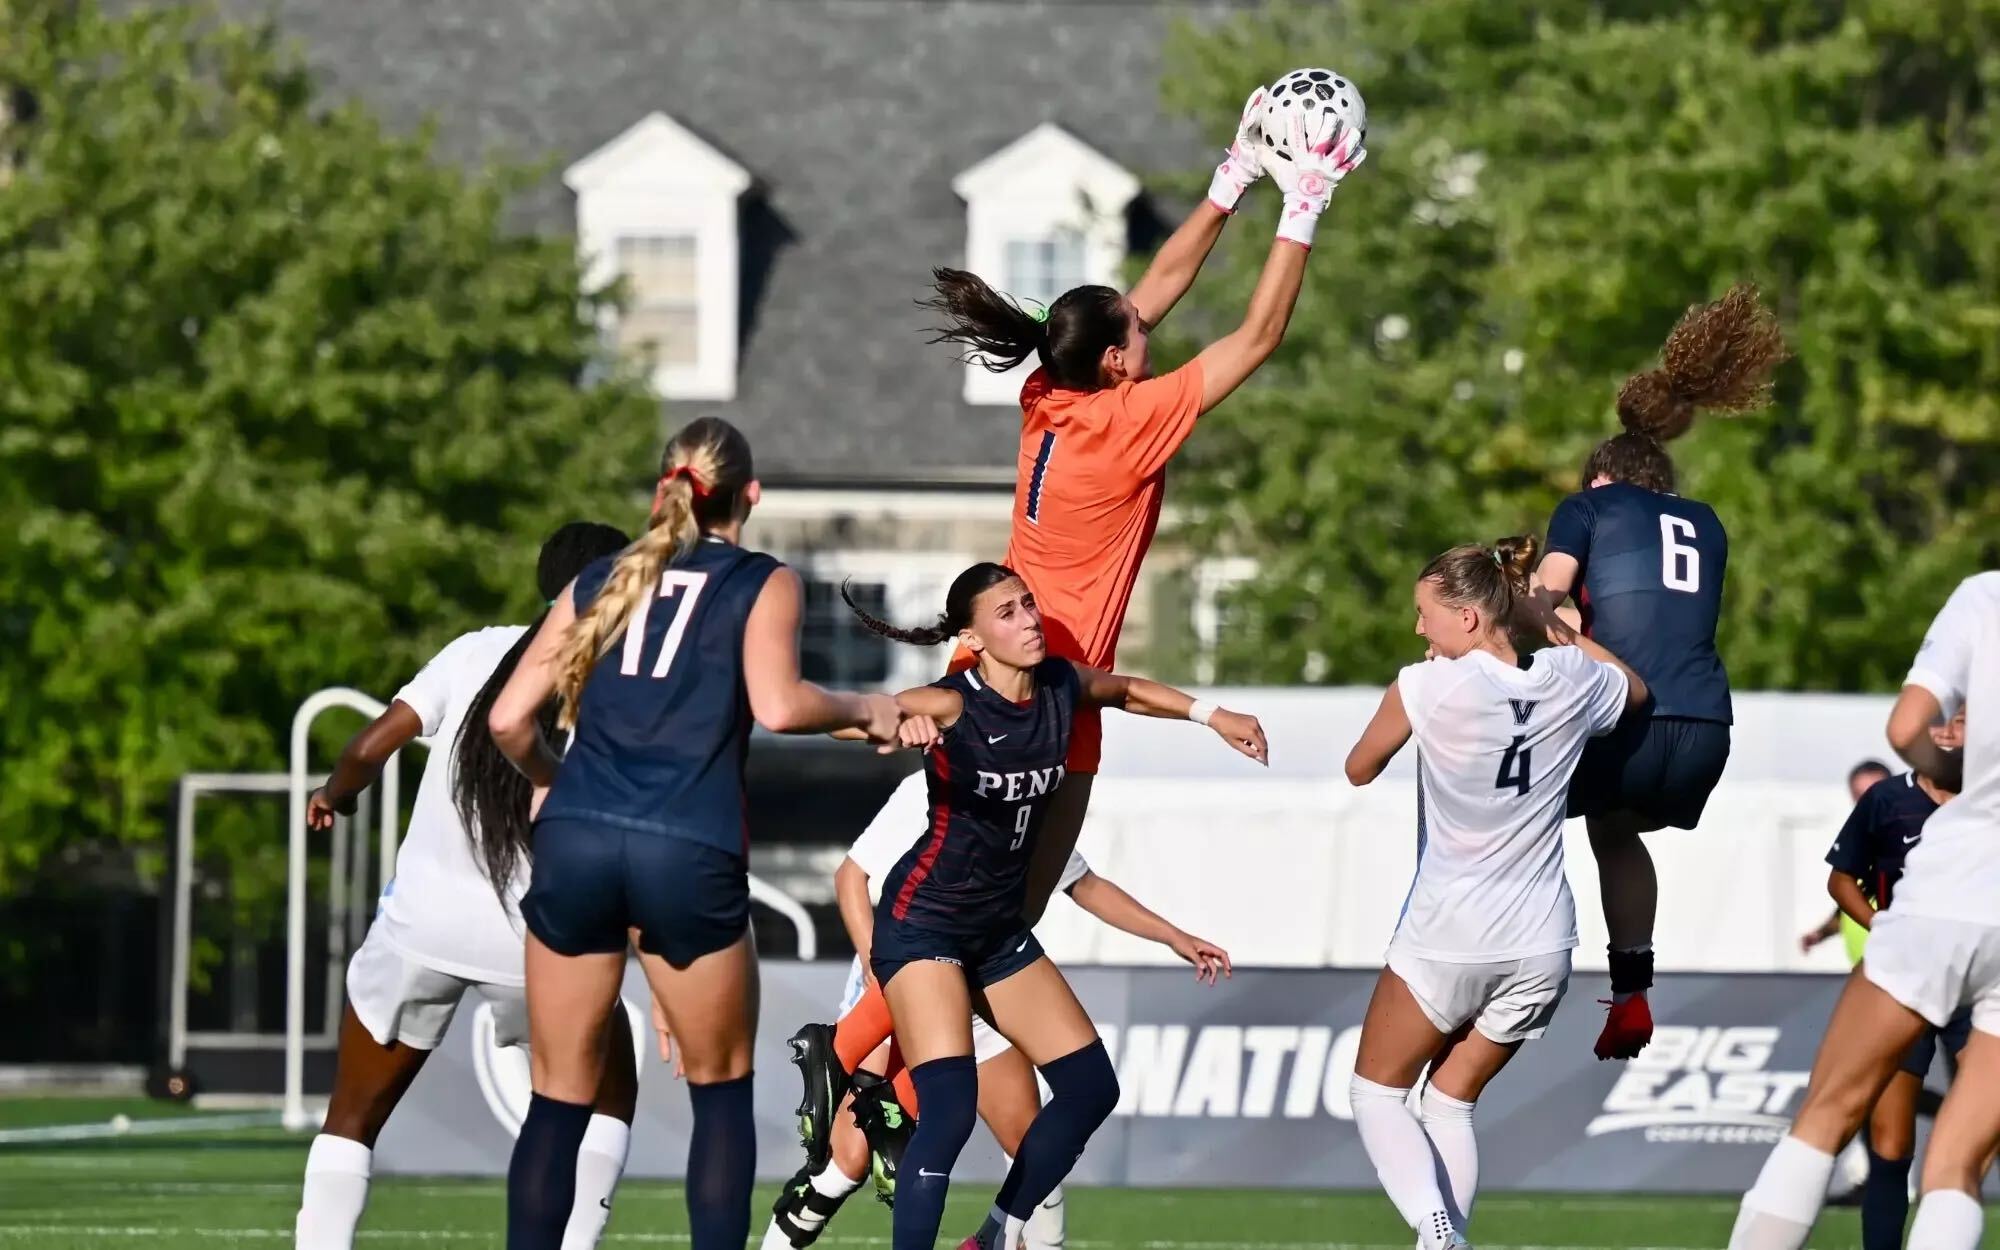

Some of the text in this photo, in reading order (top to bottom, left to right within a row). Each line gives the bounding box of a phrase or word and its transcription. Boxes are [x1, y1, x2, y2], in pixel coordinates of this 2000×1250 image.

[1025, 429, 1056, 525] 1
[1659, 513, 1700, 594] 6
[620, 569, 709, 678] 17
[1508, 698, 1541, 726] V
[1495, 734, 1532, 797] 4
[1009, 804, 1032, 851] 9
[1627, 1025, 1782, 1073] BIG
[1602, 1070, 1812, 1113] EAST
